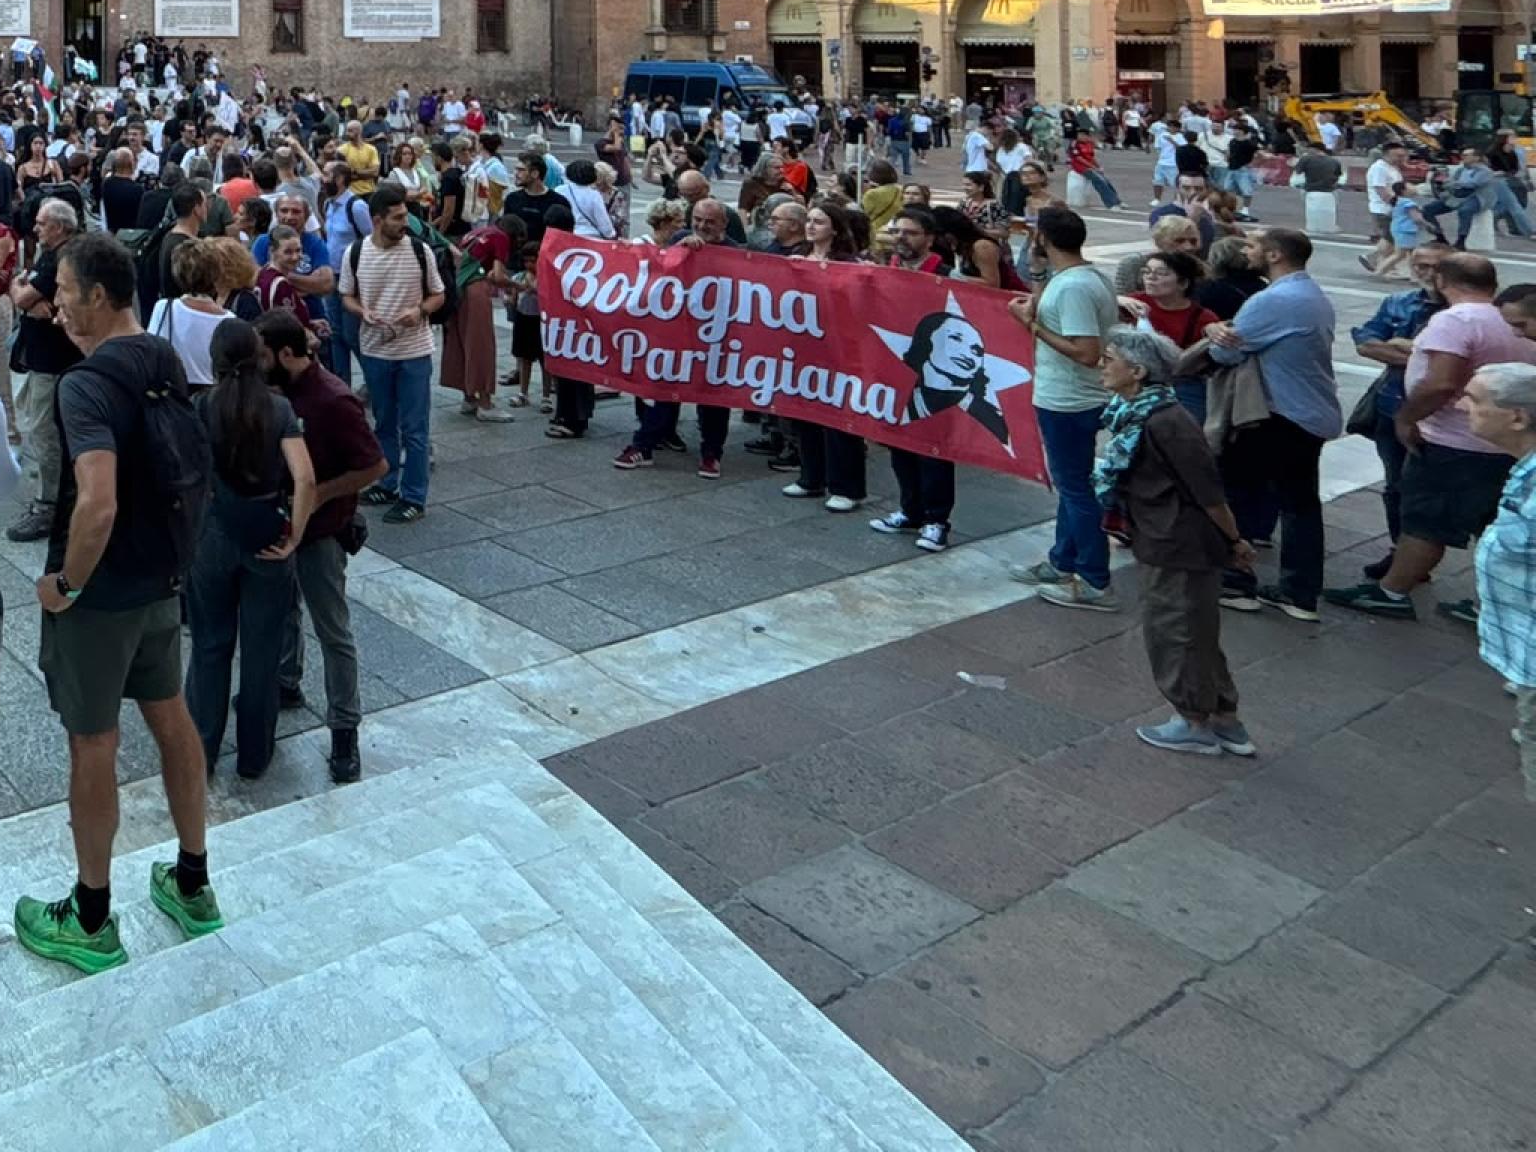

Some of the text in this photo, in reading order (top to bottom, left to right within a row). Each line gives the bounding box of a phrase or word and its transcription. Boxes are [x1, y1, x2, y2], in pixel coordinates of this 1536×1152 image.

[552, 247, 825, 343] Bologna
[540, 310, 899, 425] ittà Partigiana
